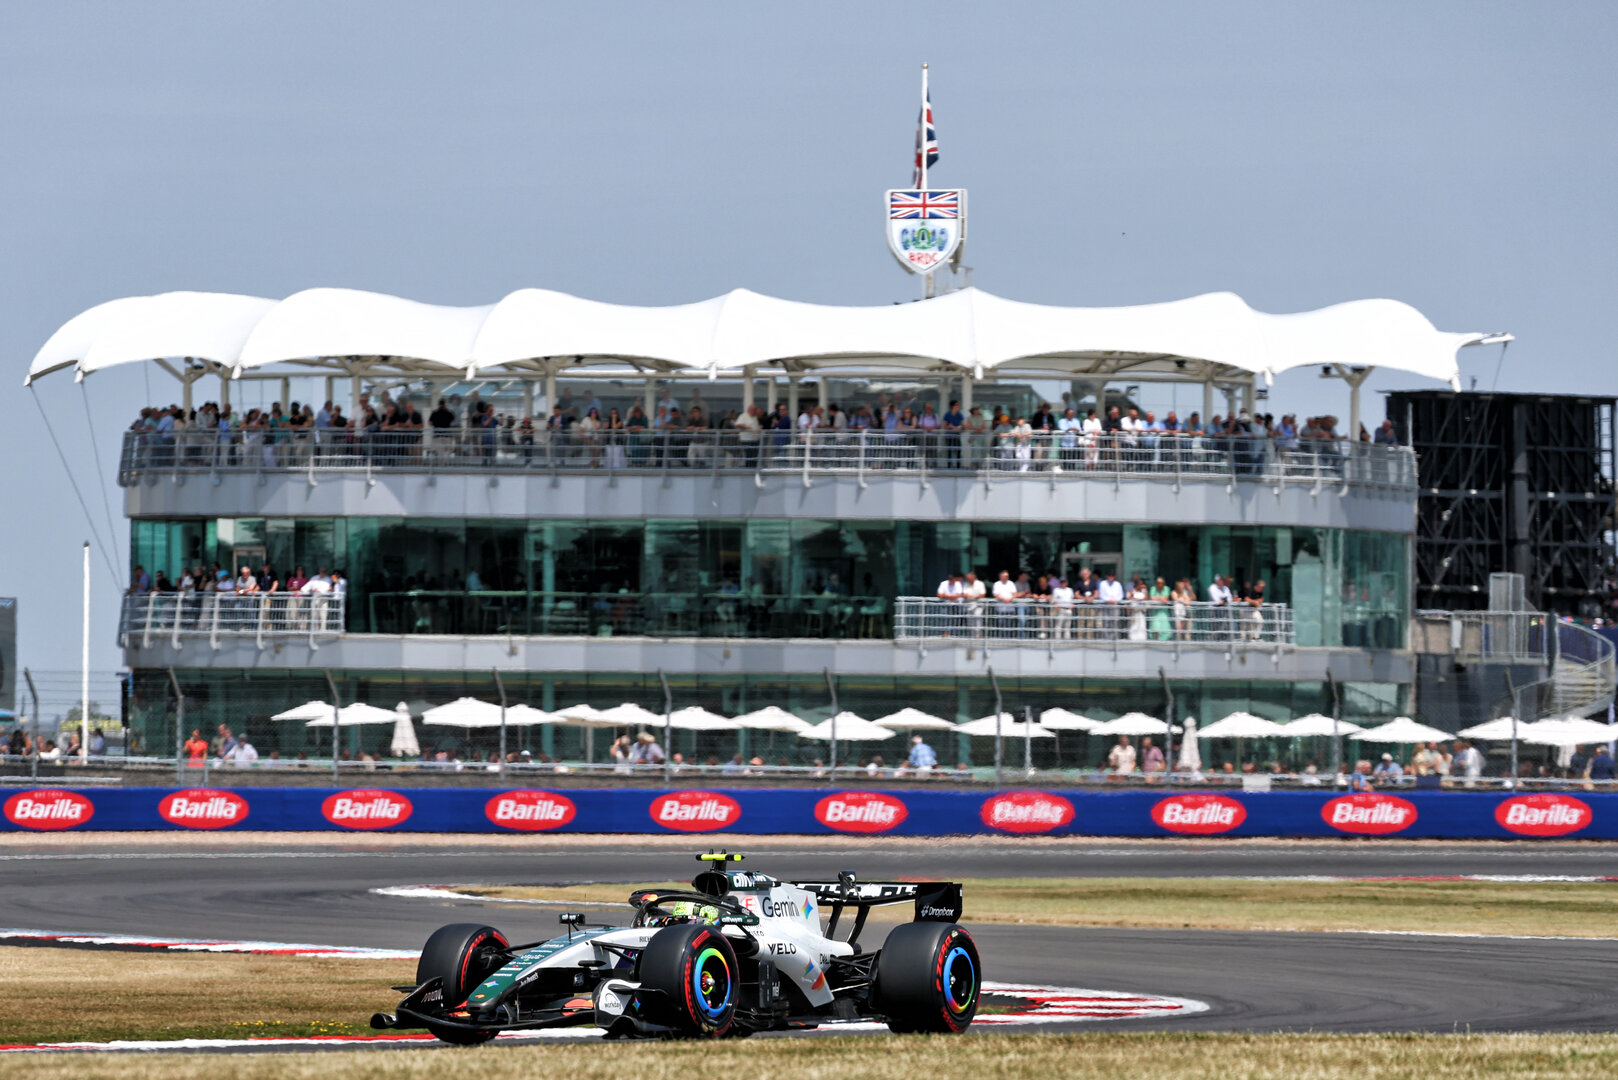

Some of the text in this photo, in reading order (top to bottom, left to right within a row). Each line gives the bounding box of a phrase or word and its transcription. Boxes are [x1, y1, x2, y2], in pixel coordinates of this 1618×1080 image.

[908, 252, 938, 264] BRDC
[14, 799, 80, 819] Barilla
[170, 798, 234, 819] Barilla
[333, 799, 399, 819] Barilla
[496, 800, 562, 821] Barilla
[660, 800, 726, 821] Barilla
[826, 801, 893, 824] Barilla
[1163, 803, 1233, 825] Barilla
[1333, 803, 1404, 824] Barilla
[1506, 804, 1579, 825] Barilla
[762, 895, 800, 917] Gemini
[928, 906, 955, 918] Dropbox
[767, 943, 797, 955] VELO
[604, 1001, 622, 1009] workday
